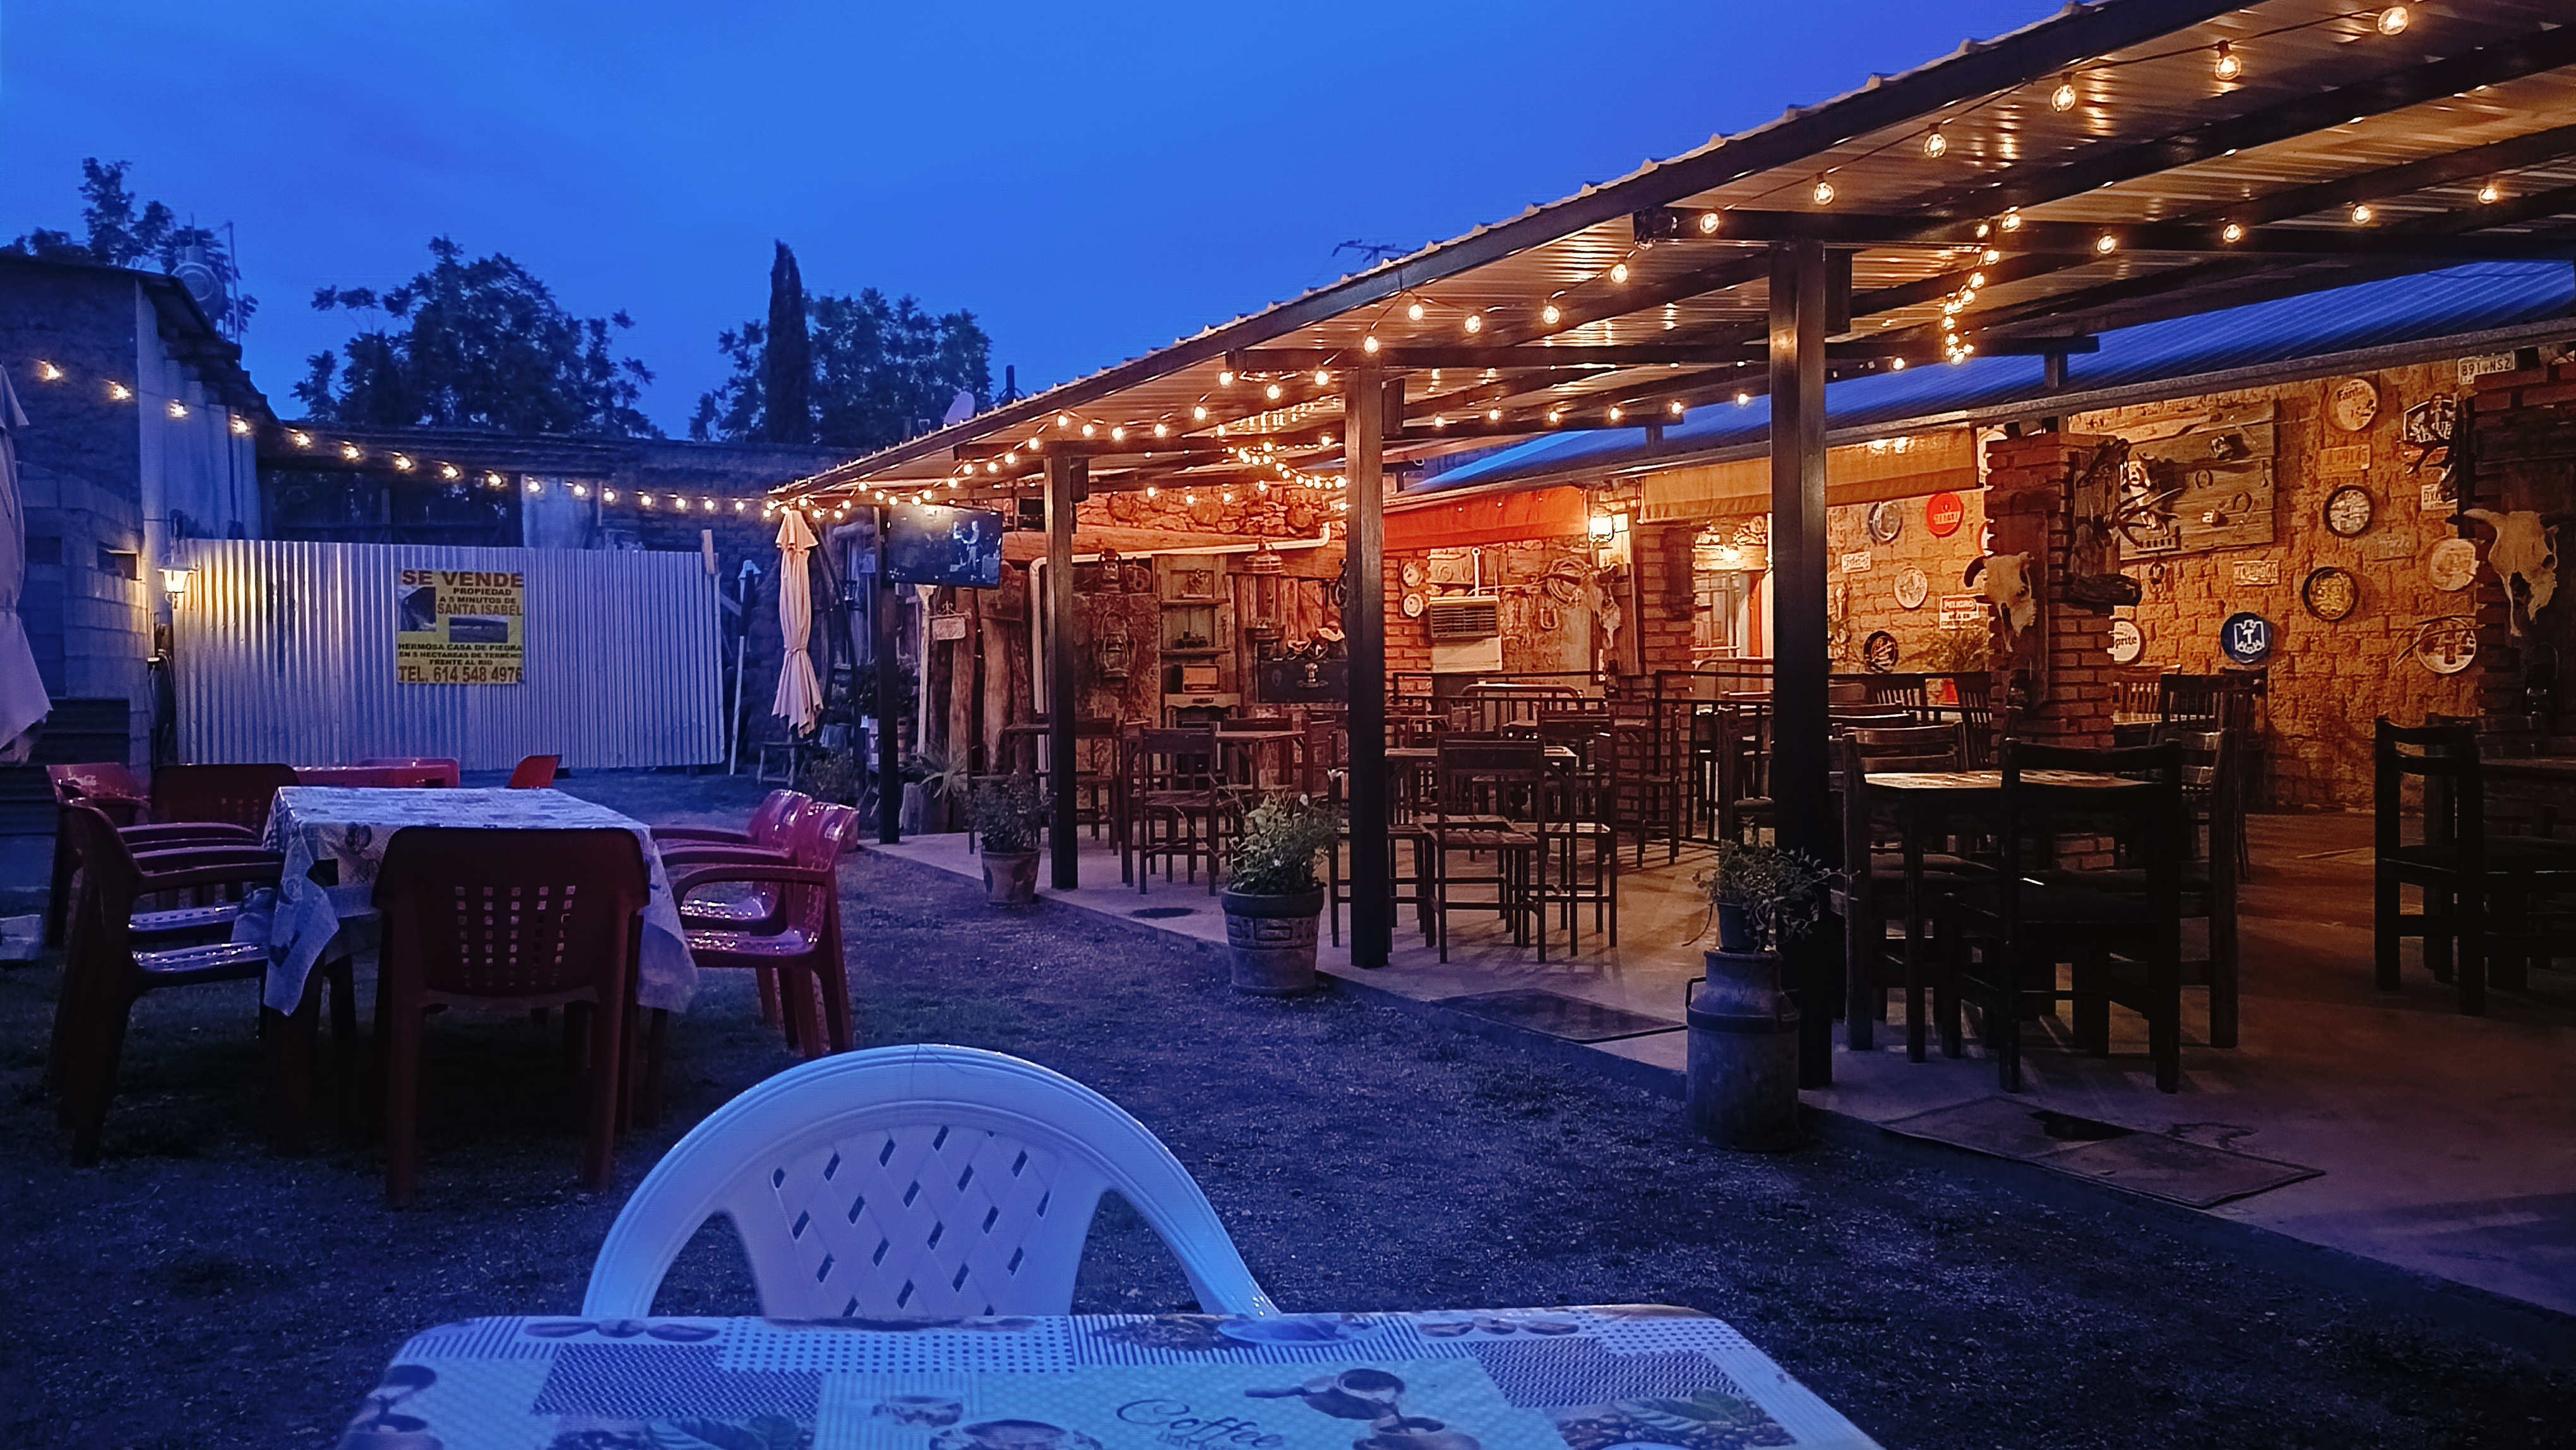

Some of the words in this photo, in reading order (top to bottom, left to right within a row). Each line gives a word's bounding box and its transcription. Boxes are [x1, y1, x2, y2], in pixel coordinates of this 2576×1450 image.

[2462, 362, 2481, 376] 891
[2490, 357, 2511, 372] NSZ
[2337, 386, 2365, 402] Fanta
[402, 570, 433, 585] SE
[441, 571, 524, 588] VENDE
[453, 587, 511, 596] PROPIEDAD
[437, 603, 476, 615] SANTA
[481, 604, 523, 616] ISABEL
[2114, 635, 2137, 649] prite
[398, 665, 429, 682] TEL.
[433, 666, 458, 683] 614
[462, 666, 487, 683] 548
[491, 666, 523, 683] 4976
[1116, 1398, 1284, 1448] Coffee
